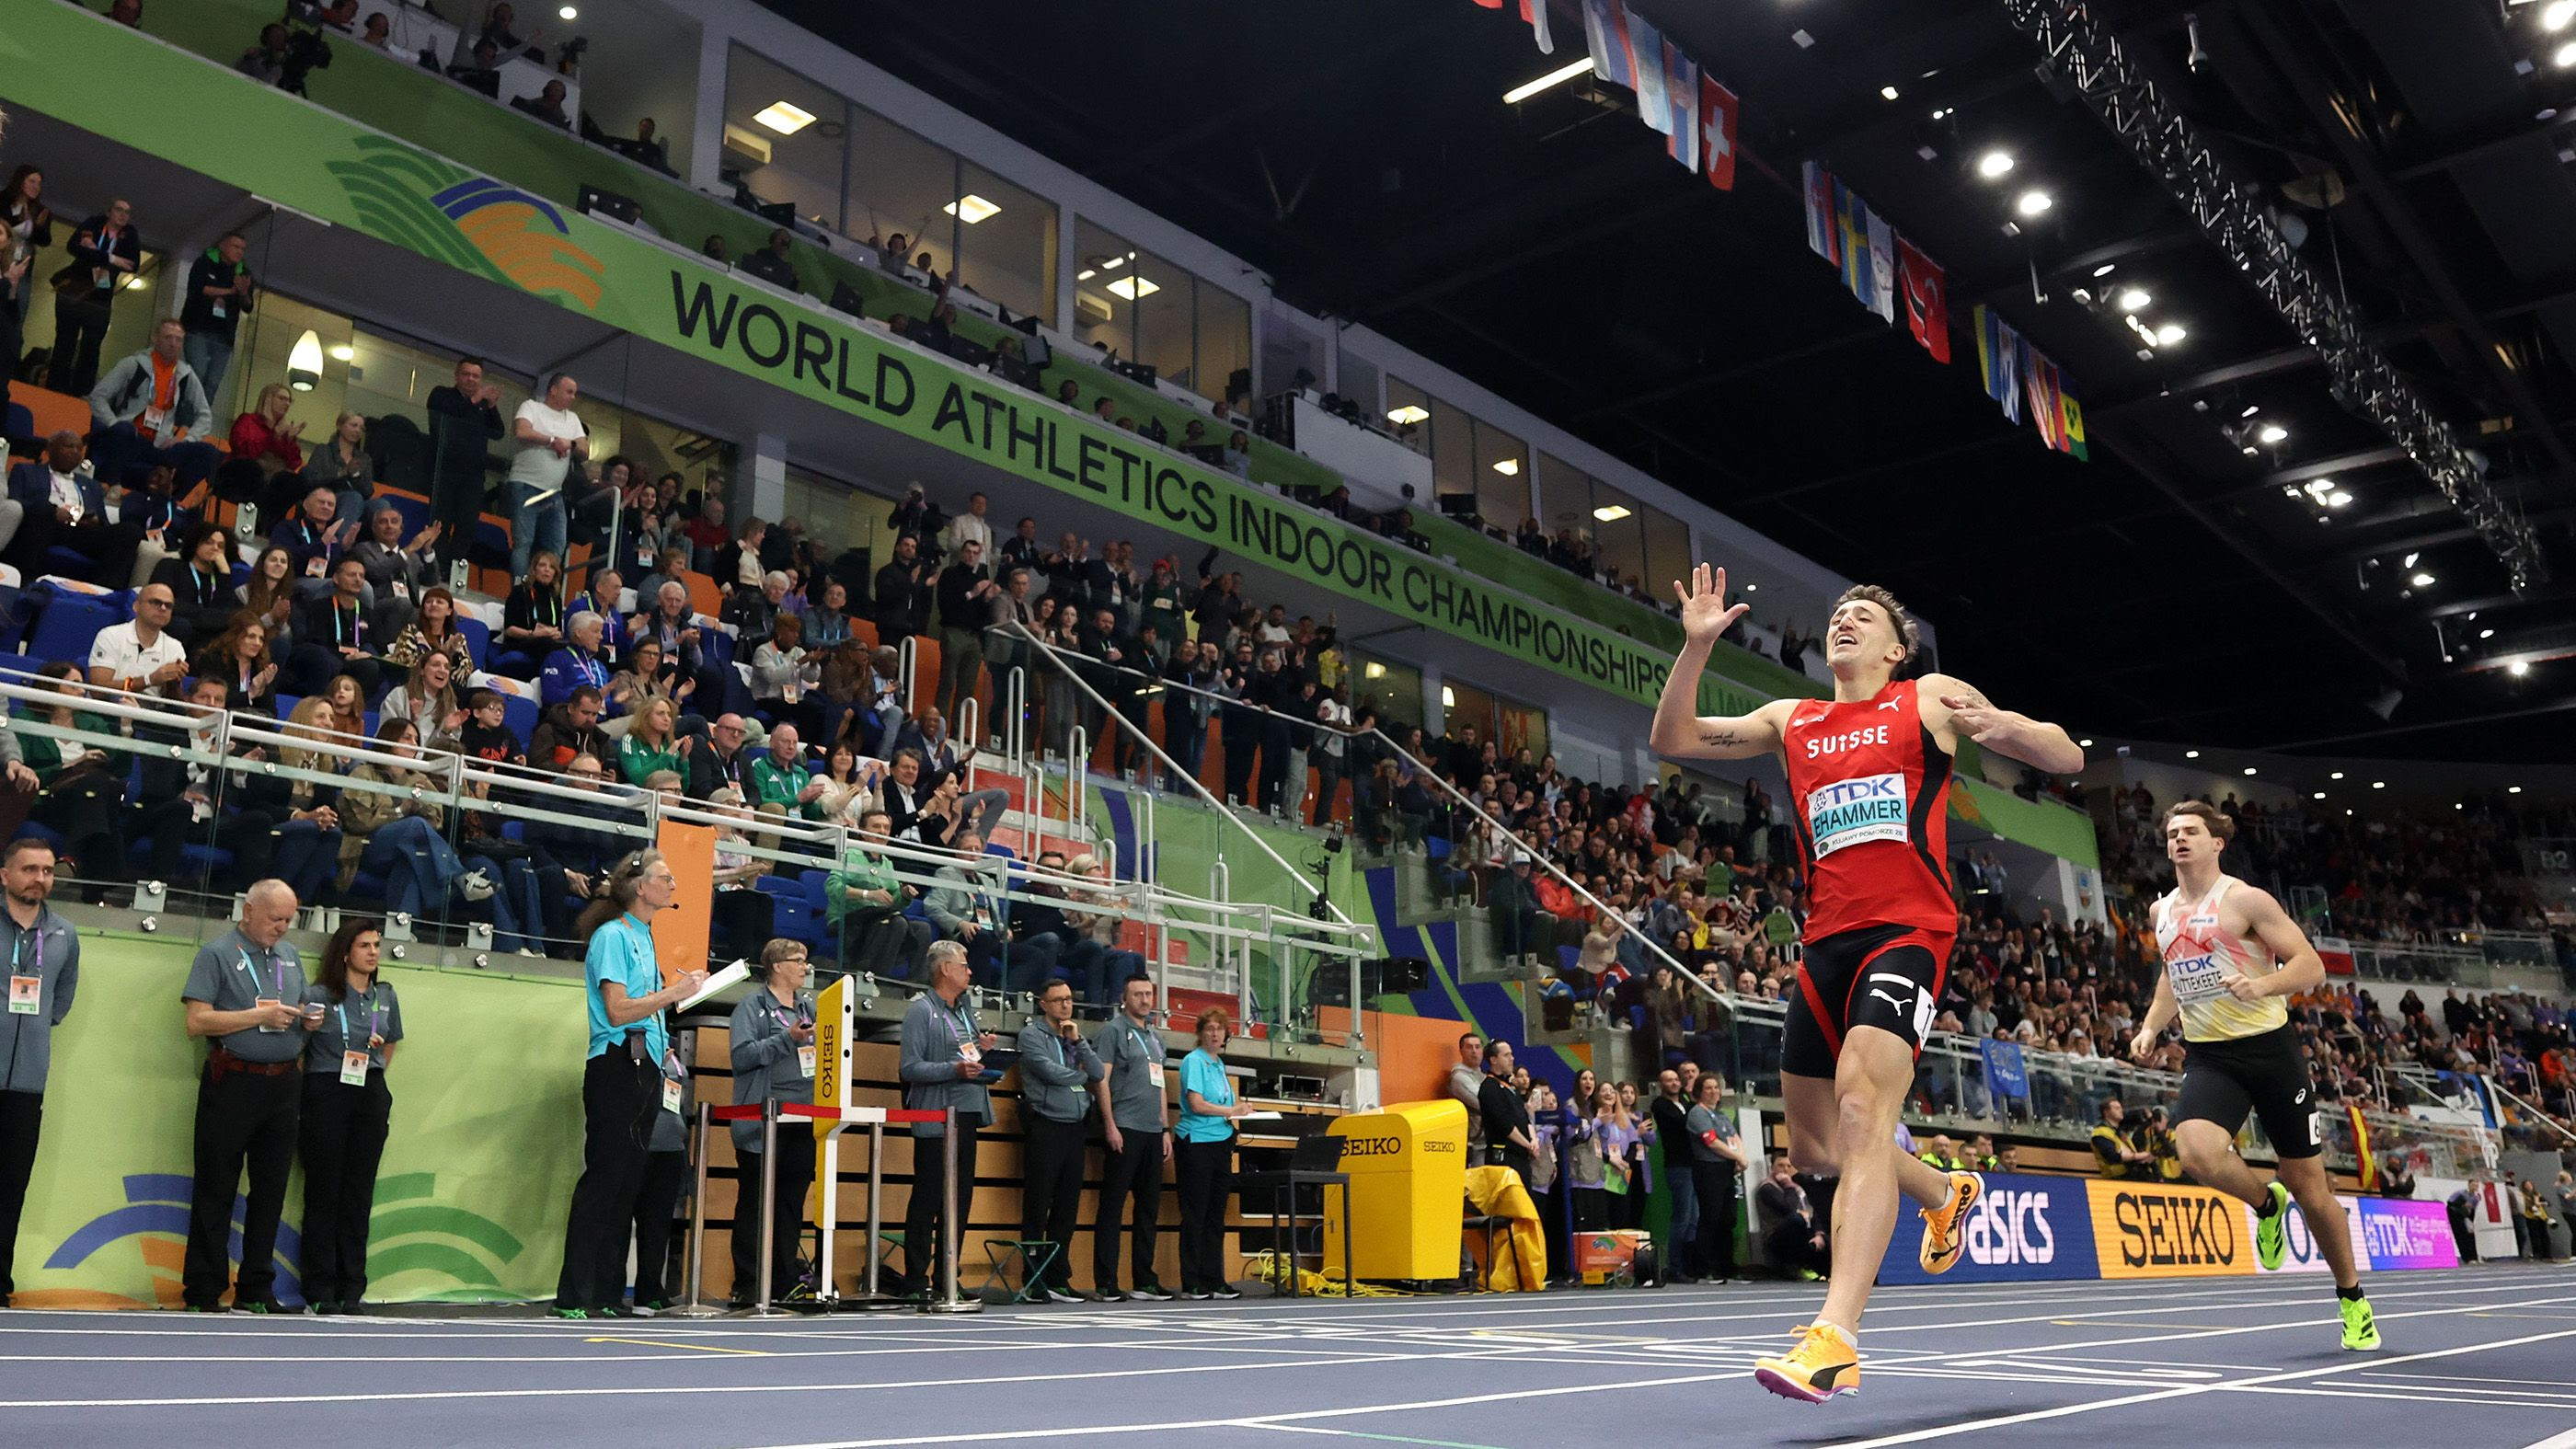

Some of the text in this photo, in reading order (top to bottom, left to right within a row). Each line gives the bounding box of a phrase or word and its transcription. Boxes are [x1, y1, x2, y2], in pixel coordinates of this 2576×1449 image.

[671, 271, 915, 418] WORLD
[931, 383, 1217, 533] ATHLETICS
[1230, 493, 1392, 601] INDOOR
[1402, 566, 1667, 700] CHAMPIONSHIPS
[1826, 777, 1897, 805] TDK
[1812, 799, 1903, 838] EHAMMER
[1832, 833, 1858, 845] KUJAWY
[1858, 829, 1893, 838] POMORZE
[2174, 955, 2215, 975] TDK
[822, 1024, 834, 1098] SEIKO
[1340, 1136, 1456, 1156] SEIKO SEIKO
[2114, 1192, 2234, 1268] SEIKO
[2374, 1213, 2415, 1257] TDK
